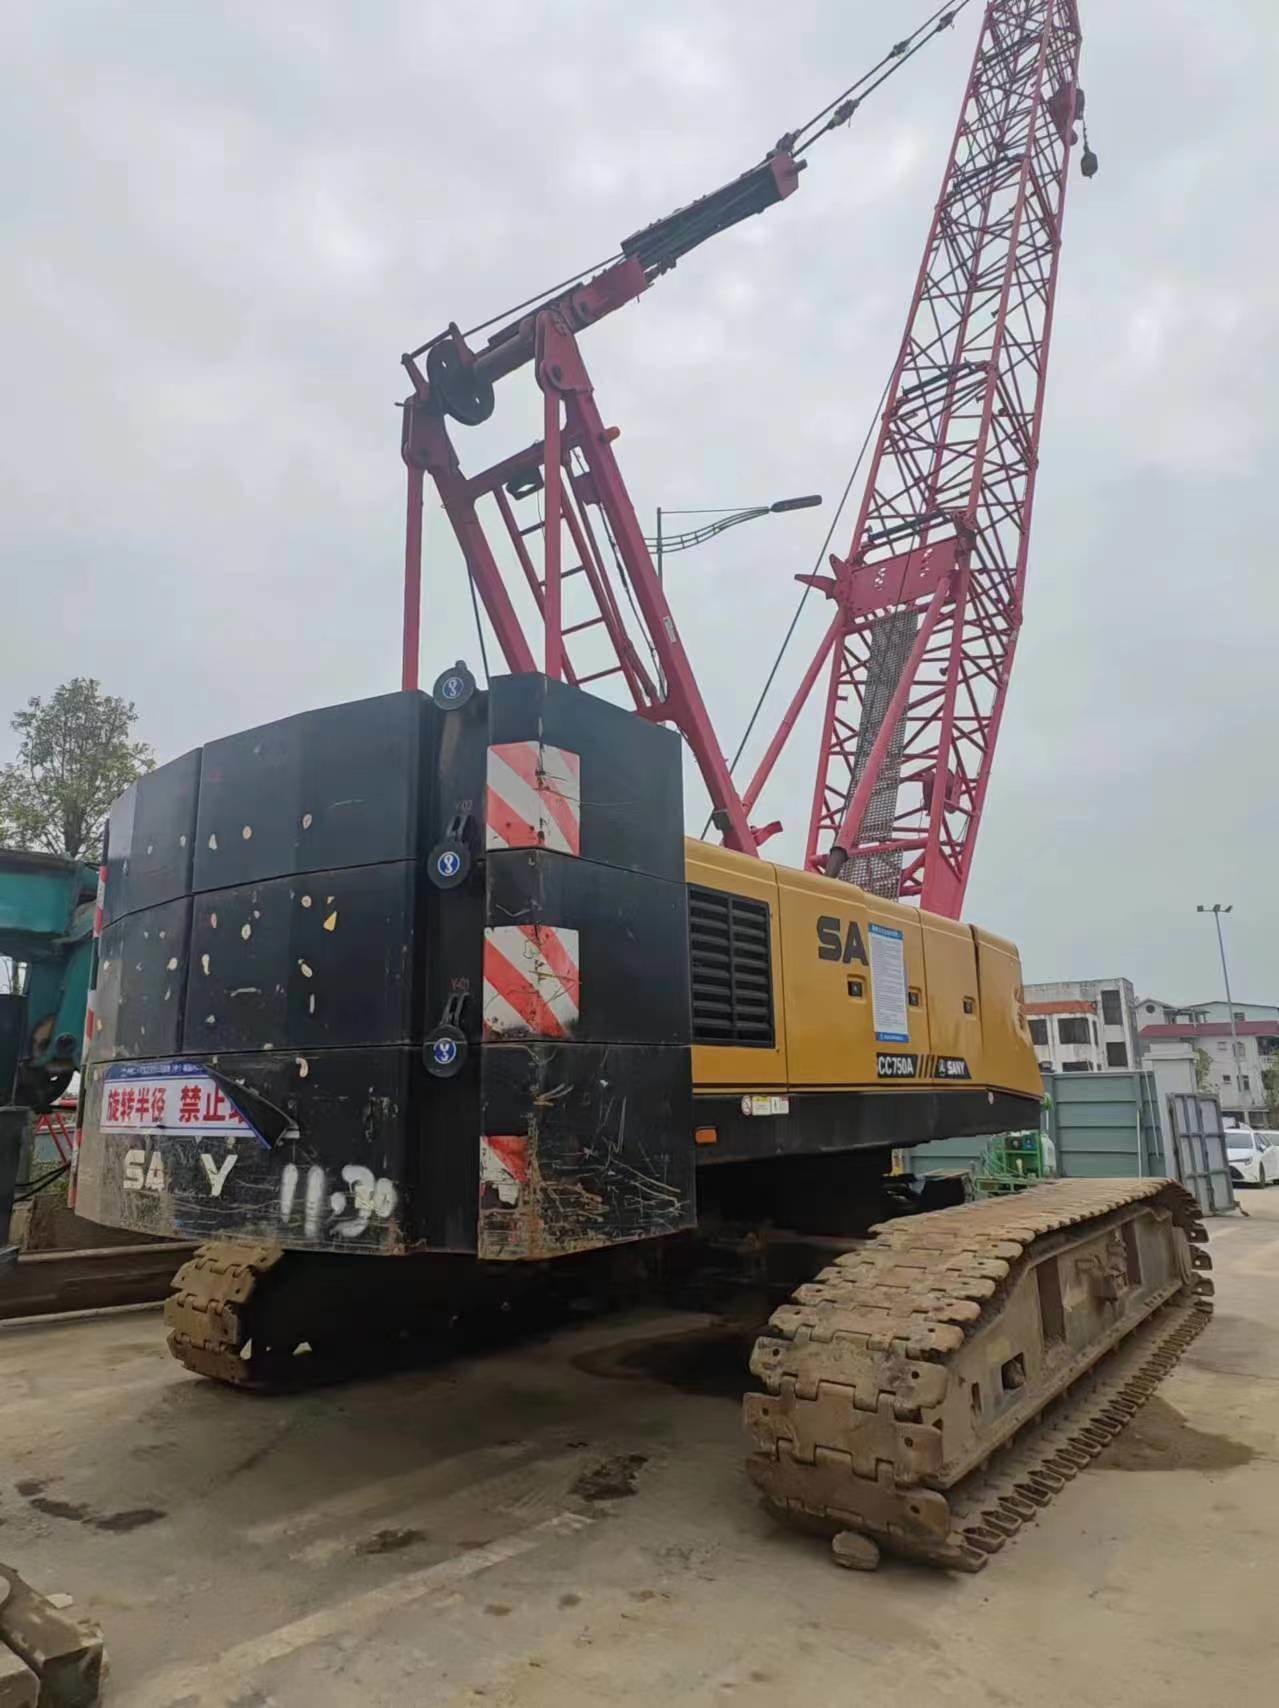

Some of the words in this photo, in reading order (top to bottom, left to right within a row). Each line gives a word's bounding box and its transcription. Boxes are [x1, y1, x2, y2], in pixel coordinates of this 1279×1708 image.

[878, 1055, 914, 1075] CC750A
[947, 1060, 965, 1076] SANY
[106, 1087, 166, 1122] 旋转半径
